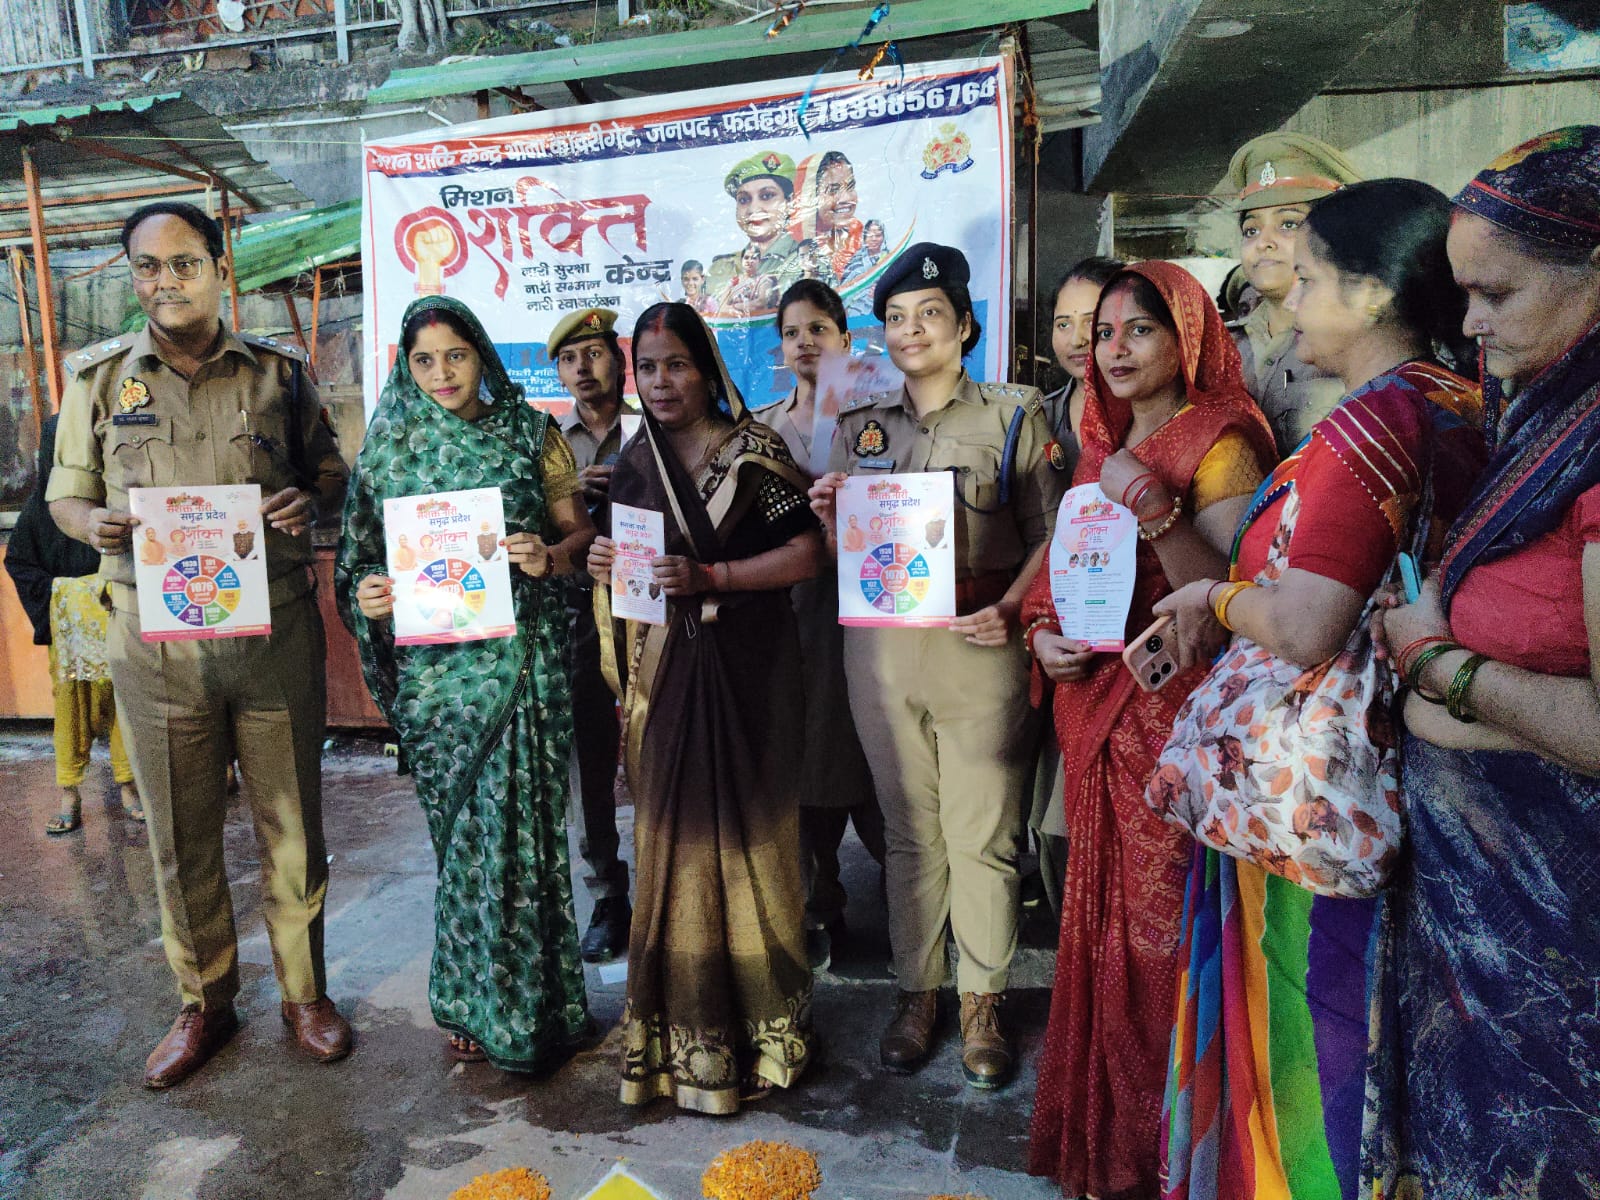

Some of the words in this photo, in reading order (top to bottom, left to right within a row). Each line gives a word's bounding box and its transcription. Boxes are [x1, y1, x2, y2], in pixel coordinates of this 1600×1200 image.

[439, 185, 513, 208] मिशन
[467, 176, 652, 301] शक्ति
[604, 255, 674, 285] केन्द्र
